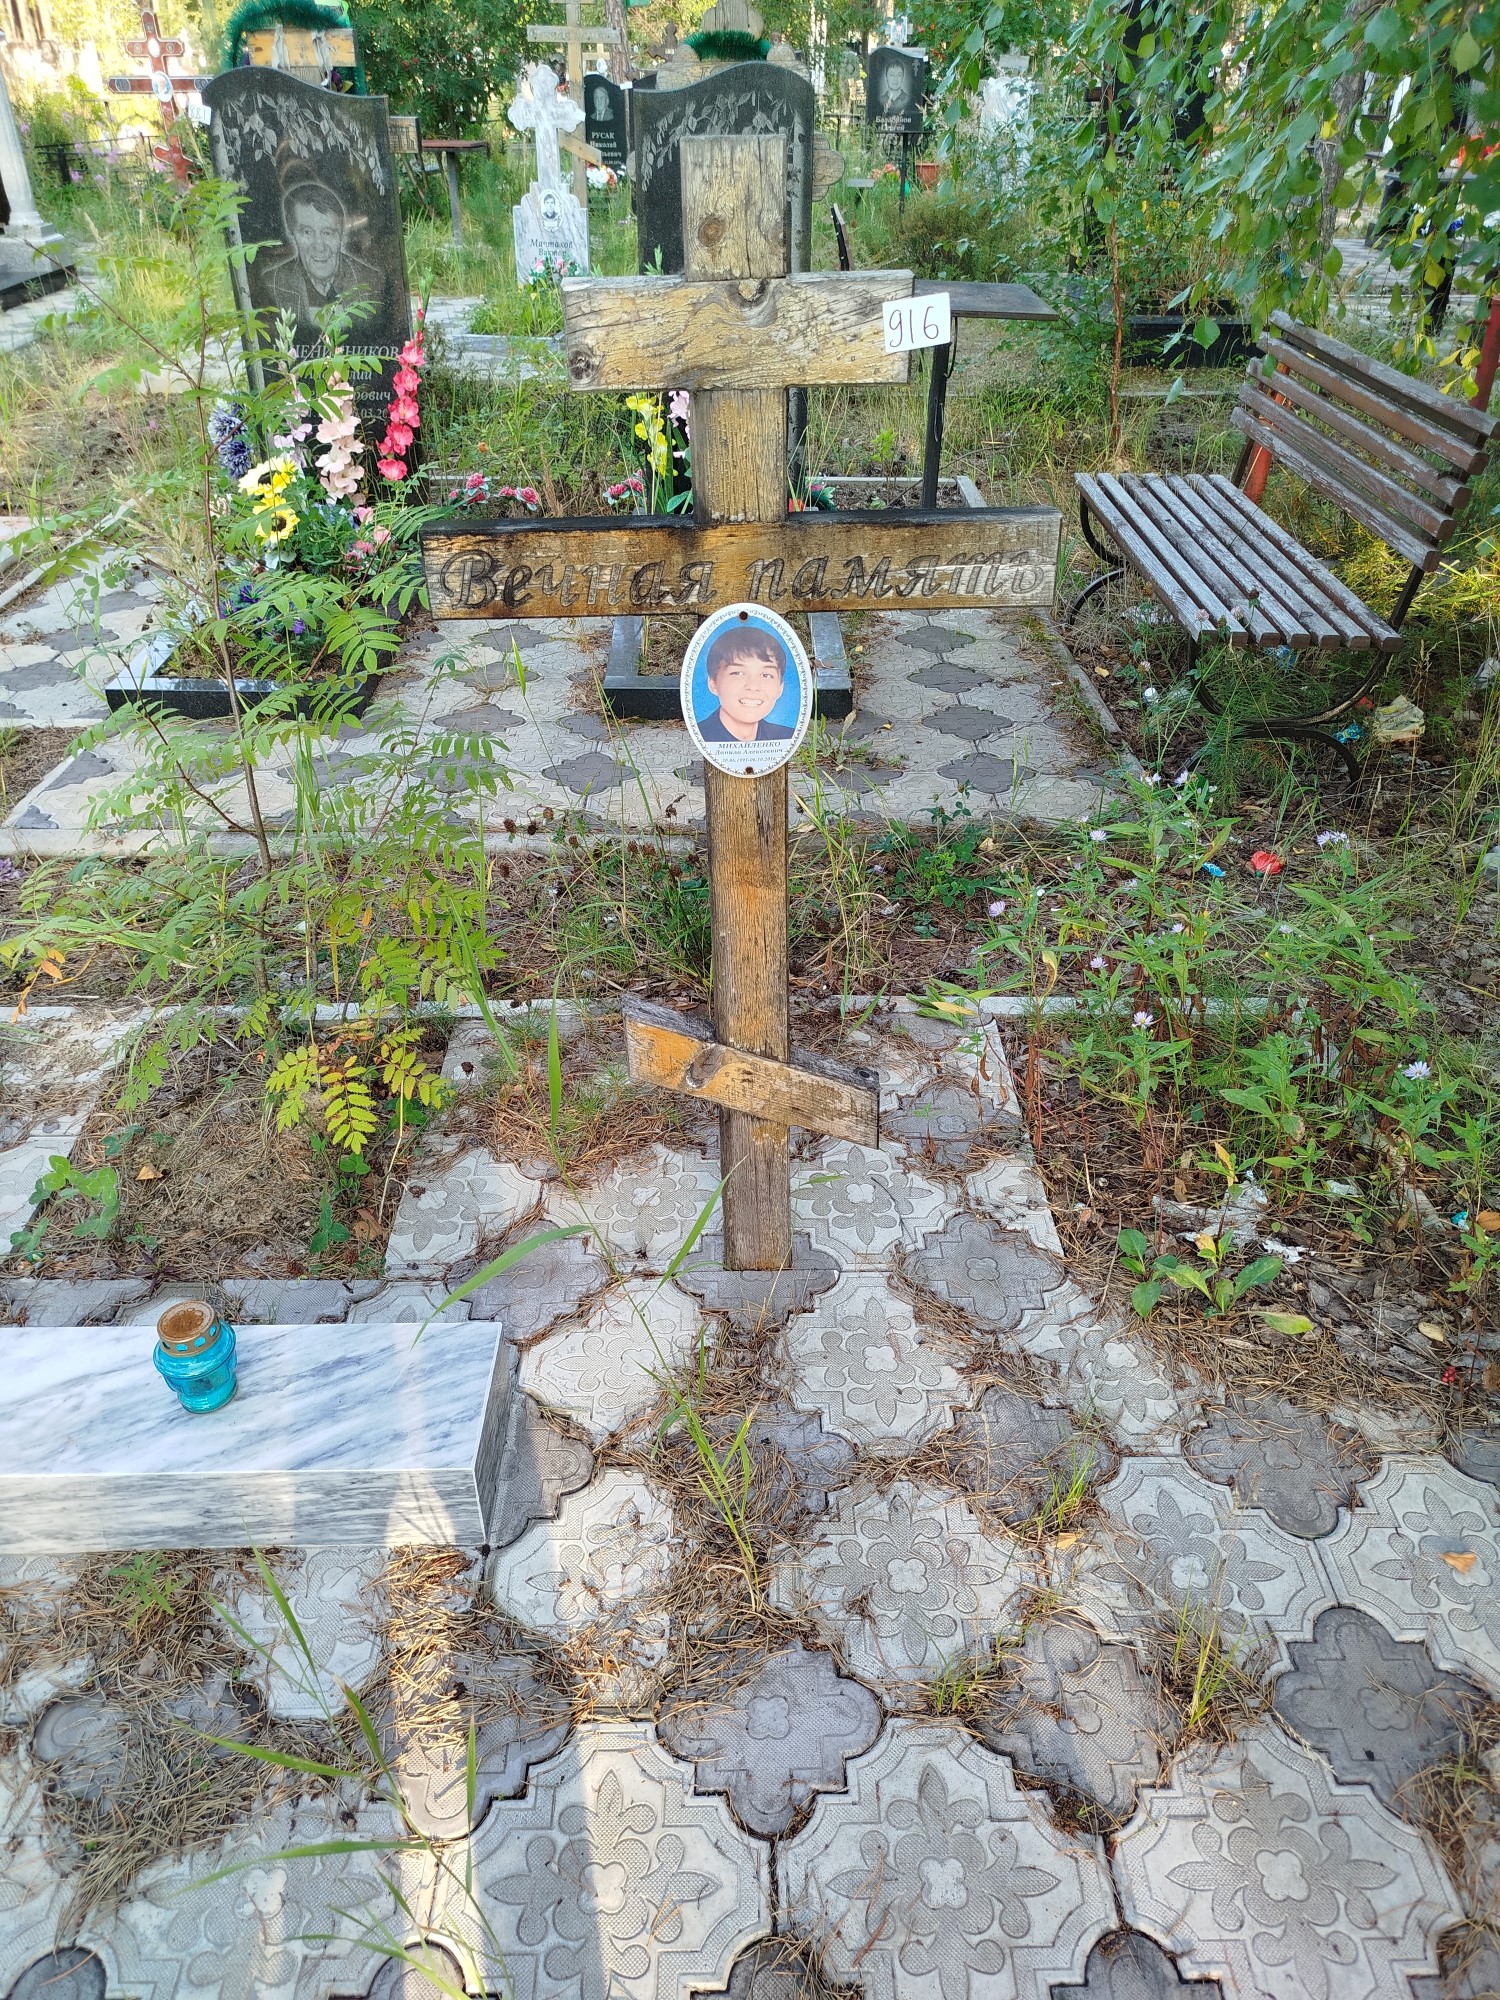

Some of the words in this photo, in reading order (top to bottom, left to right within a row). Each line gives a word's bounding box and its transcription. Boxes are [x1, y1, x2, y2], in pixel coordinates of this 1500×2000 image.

[591, 131, 615, 139] РУСАК
[889, 306, 939, 347] 916
[440, 549, 718, 609] Вечная
[745, 551, 1045, 600] память
[718, 741, 781, 749] МИХАЙЛЕНКО
